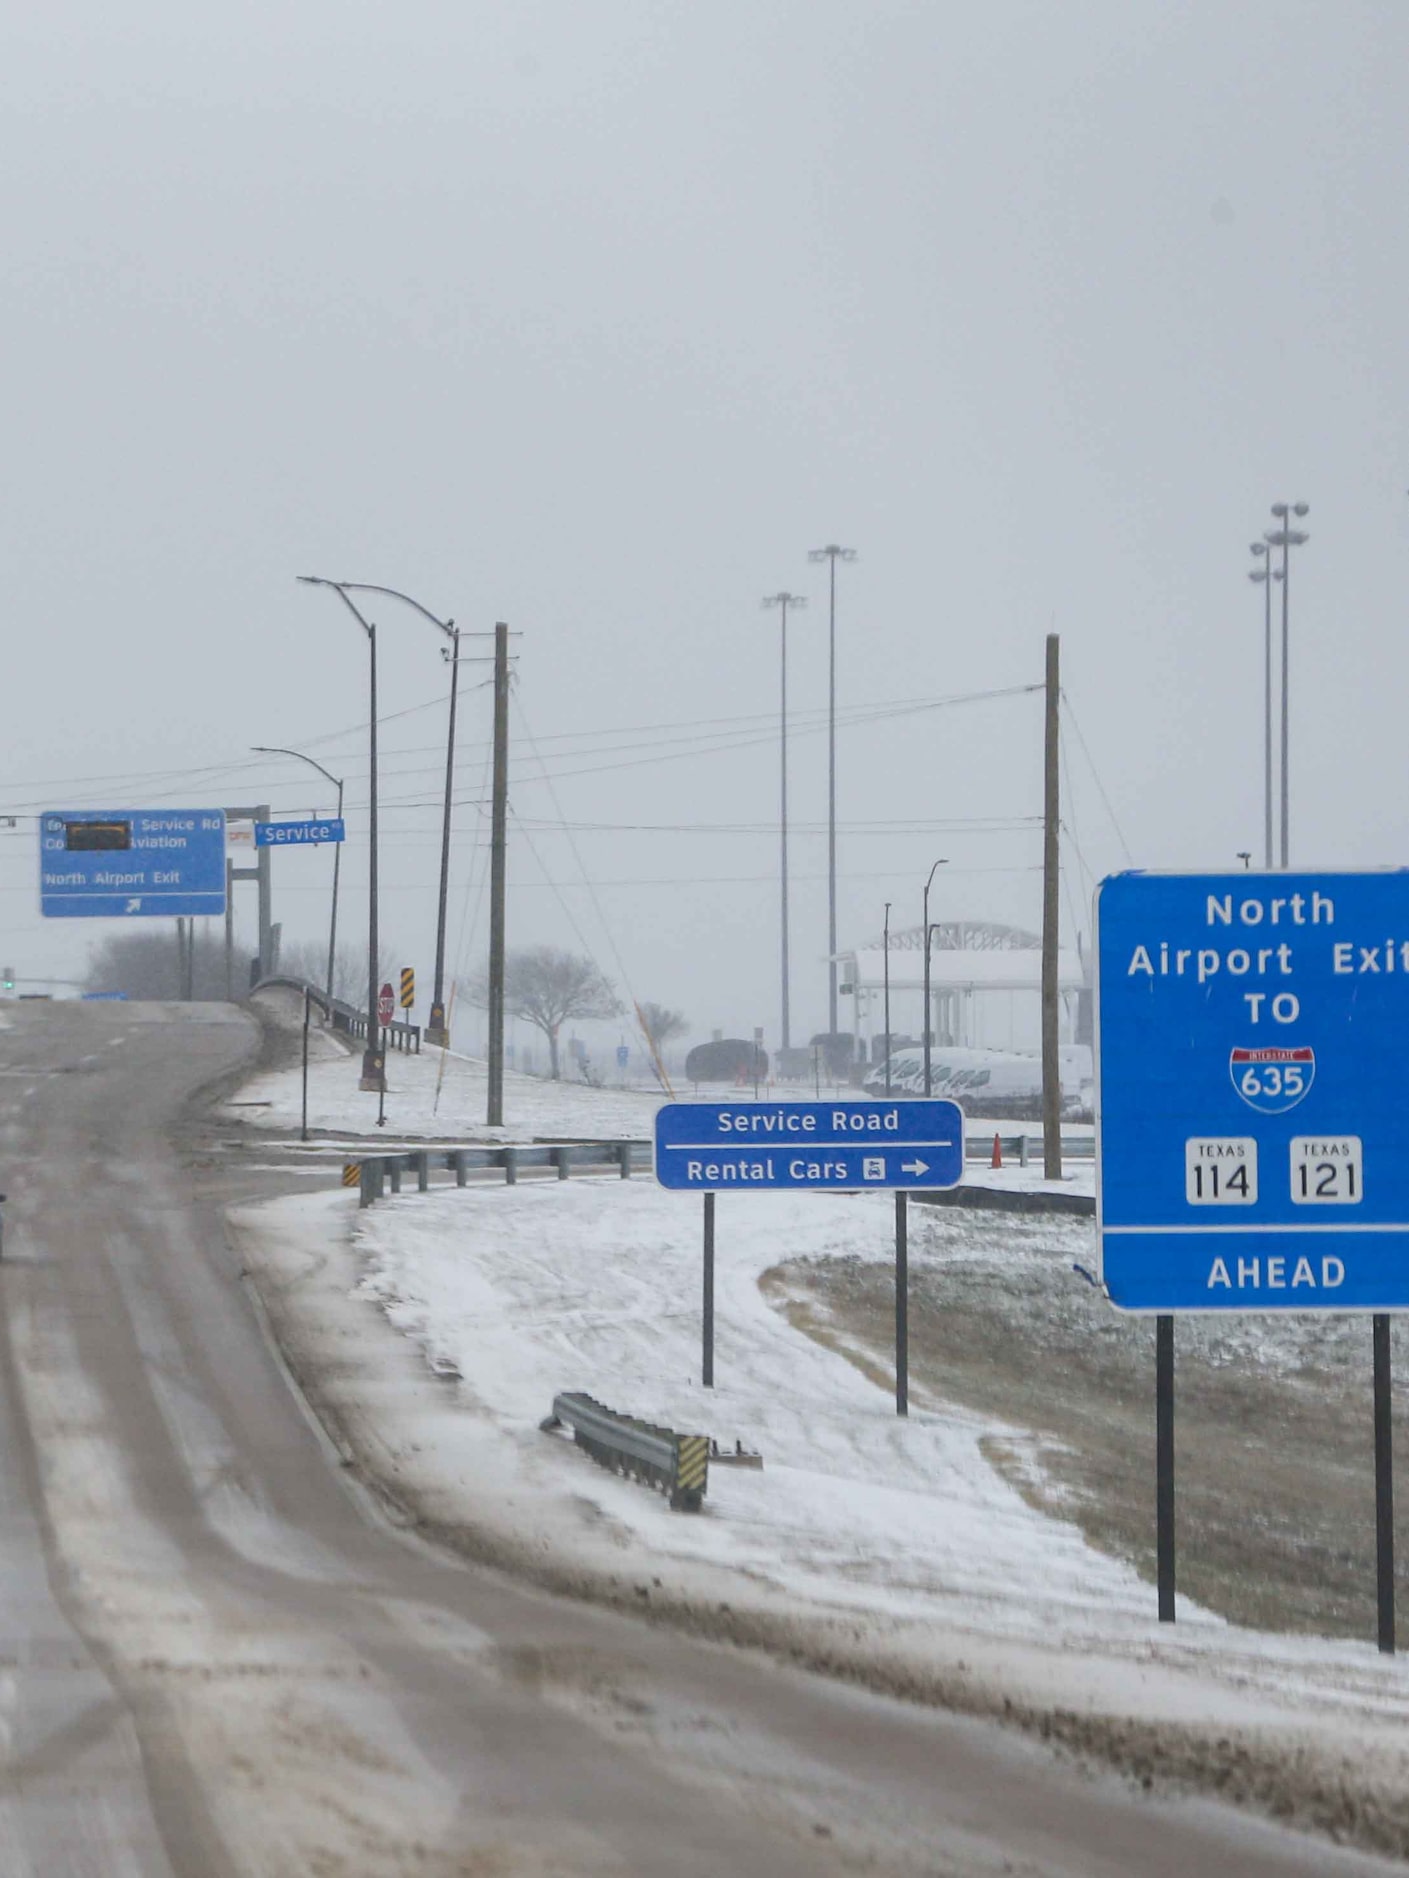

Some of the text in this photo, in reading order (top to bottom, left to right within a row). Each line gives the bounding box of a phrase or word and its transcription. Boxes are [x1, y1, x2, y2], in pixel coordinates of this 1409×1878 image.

[141, 817, 196, 831] Service
[202, 817, 221, 830] Rd
[265, 824, 330, 842] Service
[45, 870, 181, 888] North Airport Exit
[1206, 891, 1335, 926] North
[1127, 939, 1409, 984] Airport Exit
[1244, 993, 1301, 1025] TO
[1241, 1066, 1304, 1097] 635
[717, 1109, 899, 1133] Service Road
[1198, 1143, 1246, 1158] TEXAS
[1303, 1142, 1350, 1157] TEXAS
[687, 1159, 848, 1181] Rental Cars
[1193, 1164, 1250, 1199] 114
[1299, 1162, 1356, 1198] 121
[1207, 1255, 1346, 1289] AHEAD
